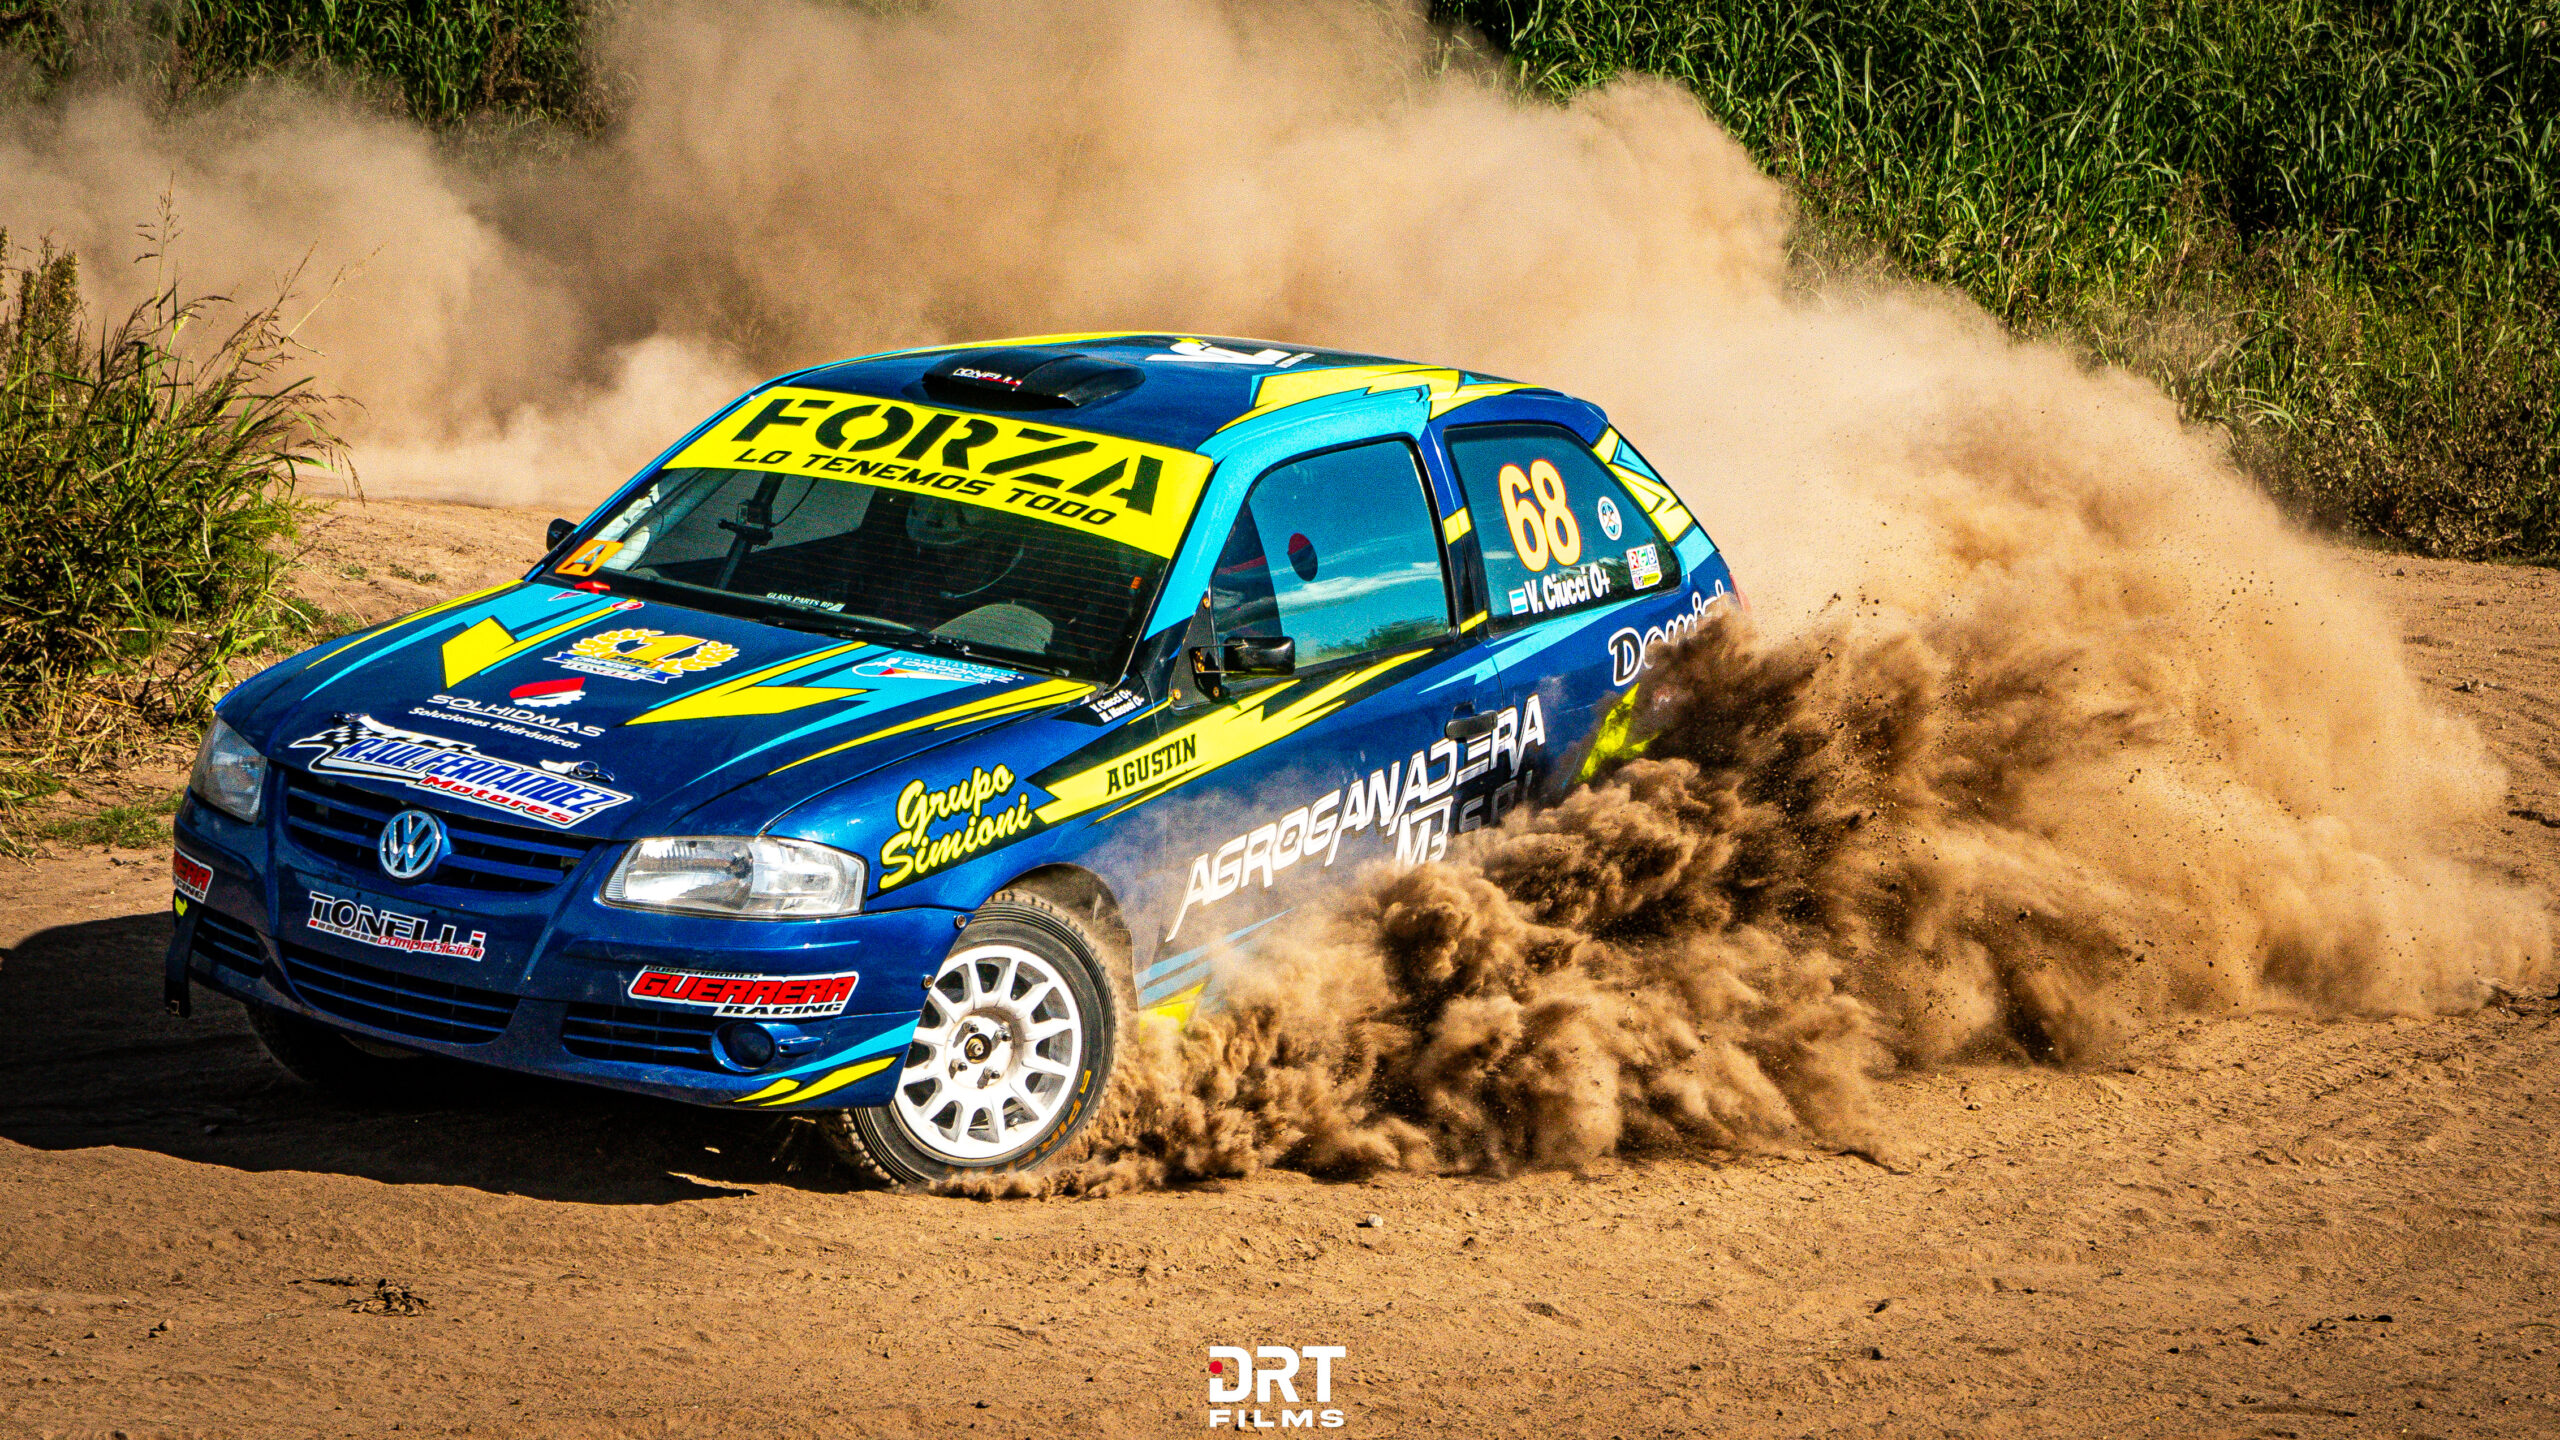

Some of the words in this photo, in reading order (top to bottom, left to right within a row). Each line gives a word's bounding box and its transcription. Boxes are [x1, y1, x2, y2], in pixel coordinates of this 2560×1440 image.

[731, 398, 1164, 516] FORZA
[734, 448, 792, 464] LO
[801, 453, 996, 496] TENEMOS
[1004, 487, 1117, 526] TODO
[1499, 459, 1581, 572] 68
[563, 543, 606, 573] A
[1628, 547, 1657, 569] RGB
[766, 592, 793, 602] GLASS
[792, 596, 820, 607] PARTS
[1524, 581, 1545, 614] V.
[1546, 569, 1592, 610] Ciucci
[1589, 562, 1611, 598] O+
[408, 707, 491, 728] Soluciones
[427, 694, 606, 737] SOLHIDMAS
[331, 738, 434, 767] RAUL
[411, 752, 619, 816] FERNANDEZ
[1106, 734, 1197, 796] AGUSTIN
[421, 775, 571, 825] Motores
[897, 764, 1014, 844] Grupo
[1166, 693, 1547, 942] AGROGANADERA
[879, 793, 1032, 889] Simioni
[309, 891, 487, 955] TONELLI
[631, 972, 857, 1005] GUERRERA
[720, 1003, 843, 1016] RACING
